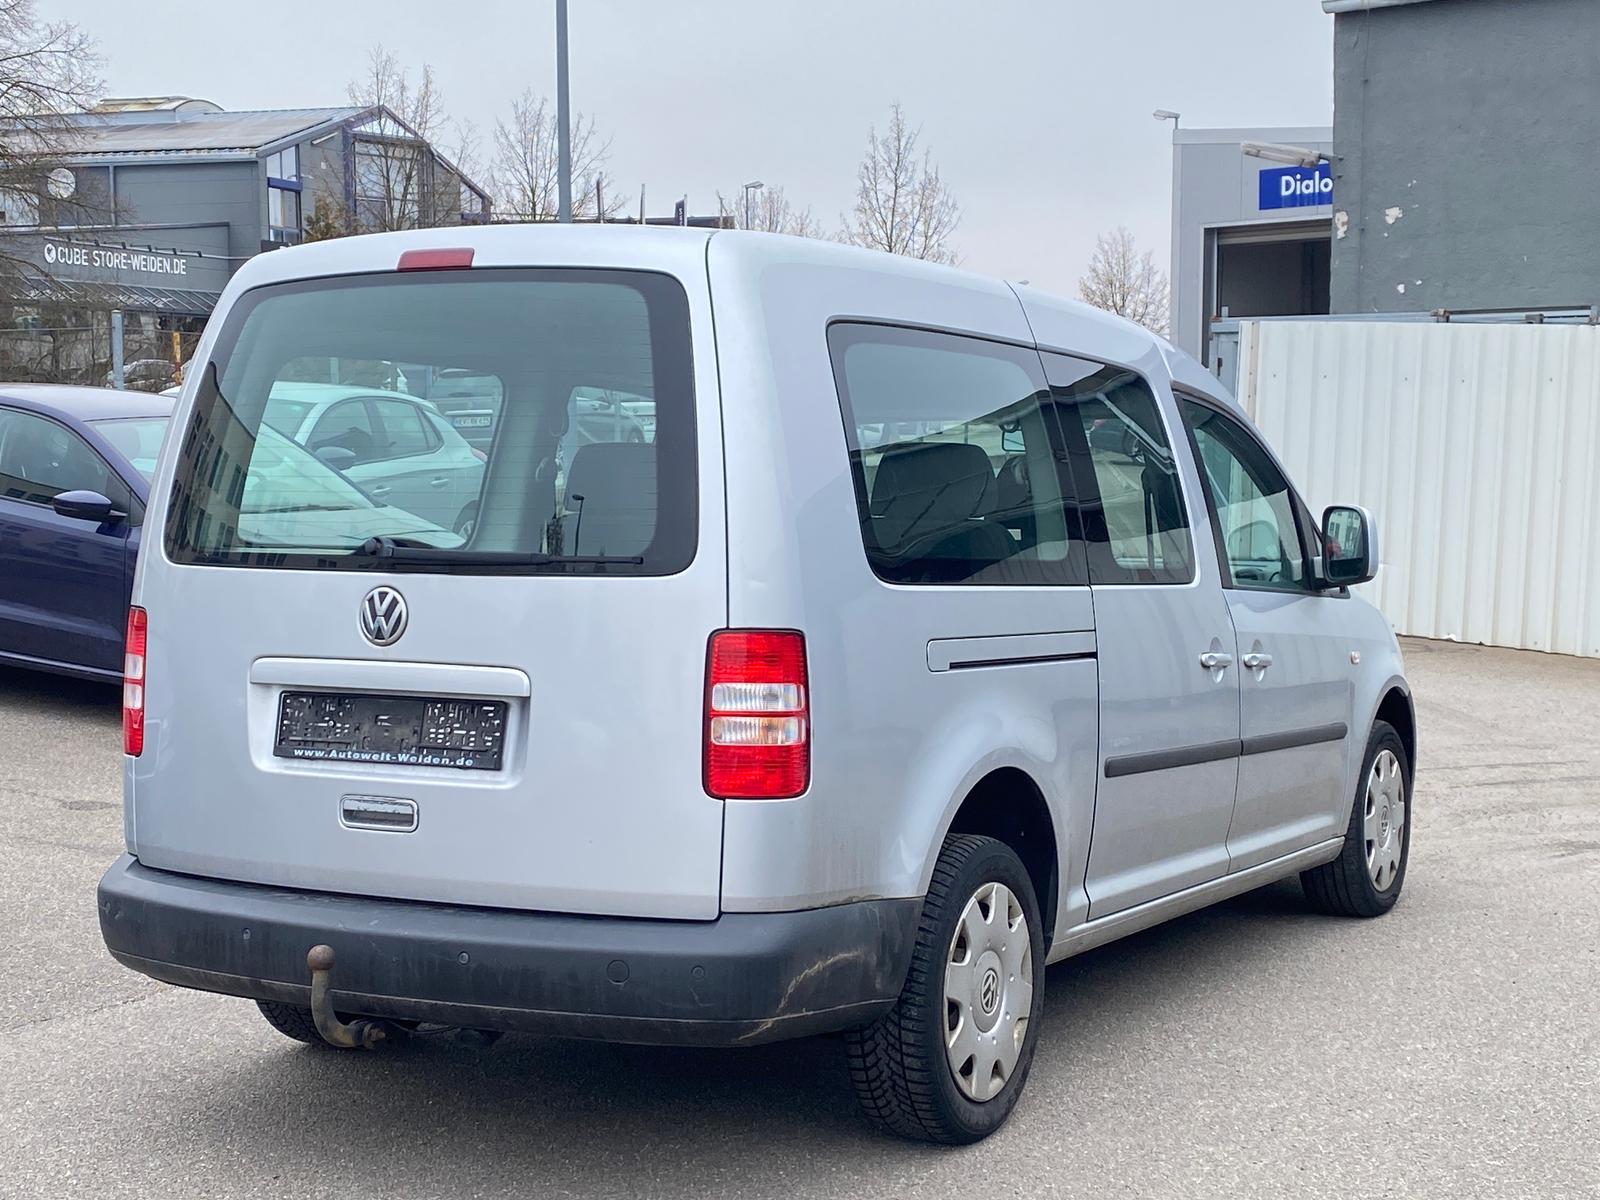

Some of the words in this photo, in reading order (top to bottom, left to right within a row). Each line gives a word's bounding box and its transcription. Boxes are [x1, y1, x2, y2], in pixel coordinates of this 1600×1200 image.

[1281, 170, 1334, 196] Dialo
[57, 246, 89, 266] CUBE
[92, 250, 187, 275] STORE-WEIDEN.DE
[293, 749, 474, 767] www.Autowelt-Weiden.de
